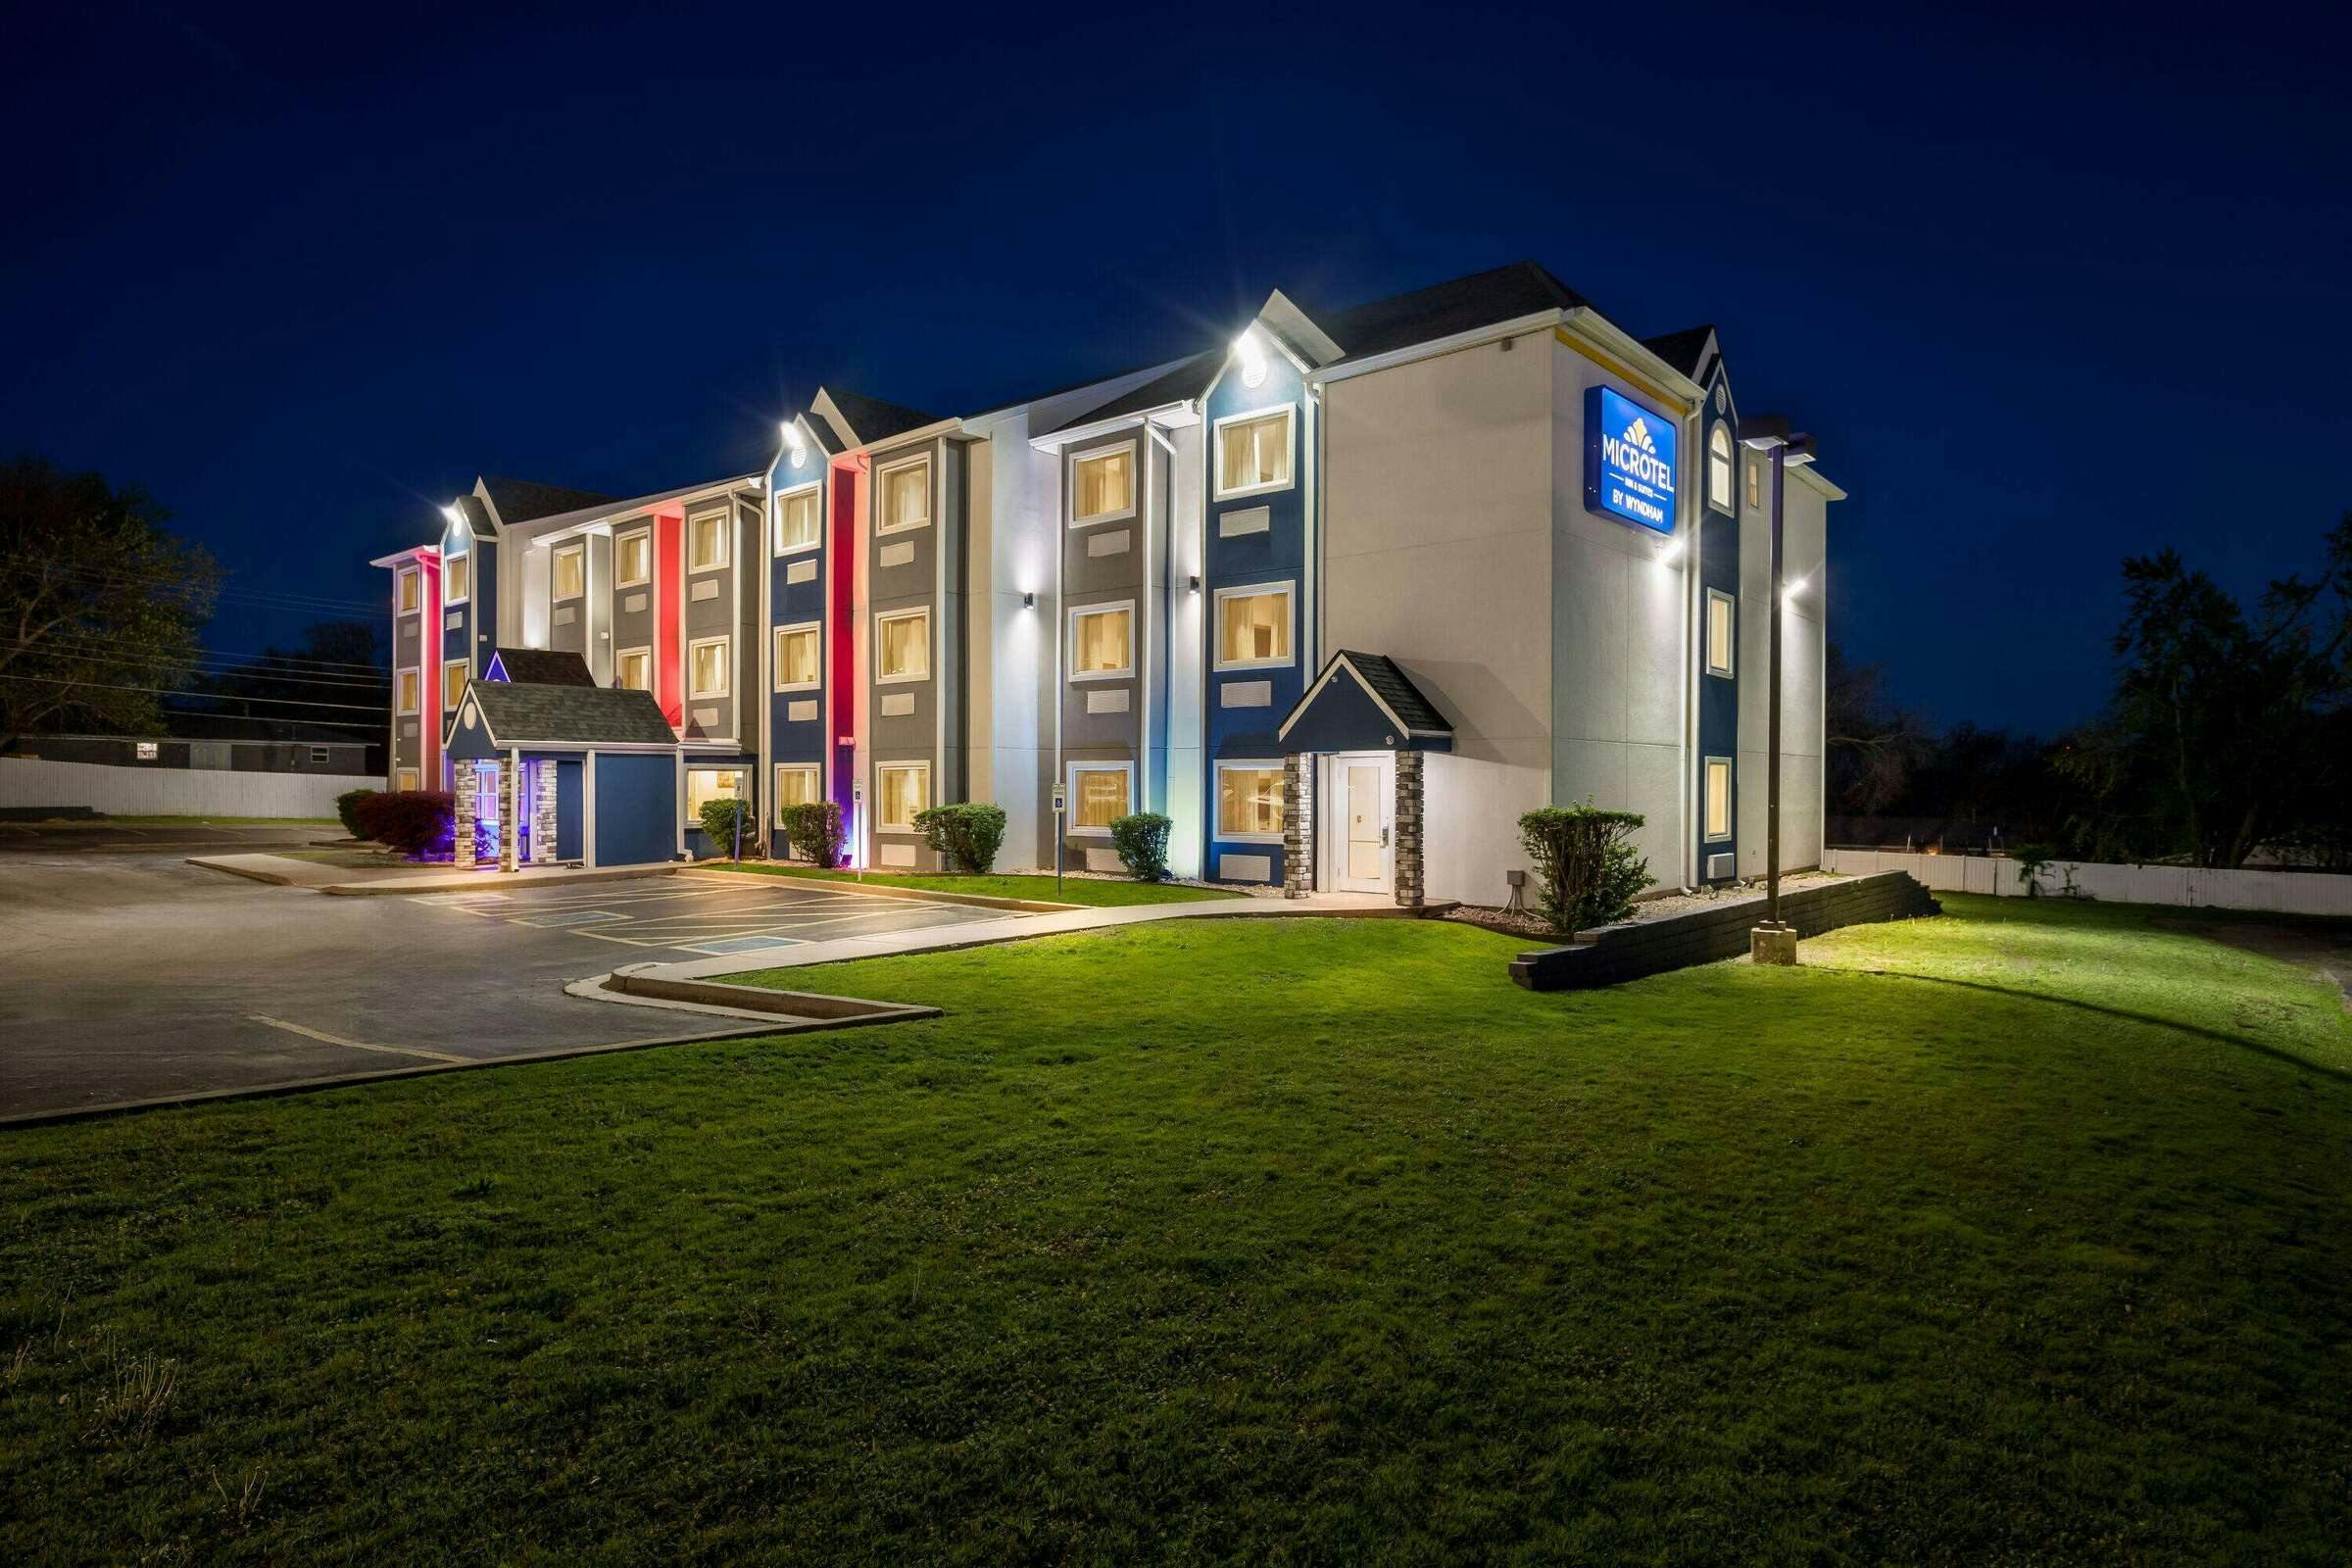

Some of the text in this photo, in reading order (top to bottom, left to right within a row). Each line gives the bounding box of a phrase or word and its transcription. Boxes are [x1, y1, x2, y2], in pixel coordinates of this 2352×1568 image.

[1602, 434, 1675, 493] MICROTEL
[1613, 488, 1663, 523] BY WYNDHAM
